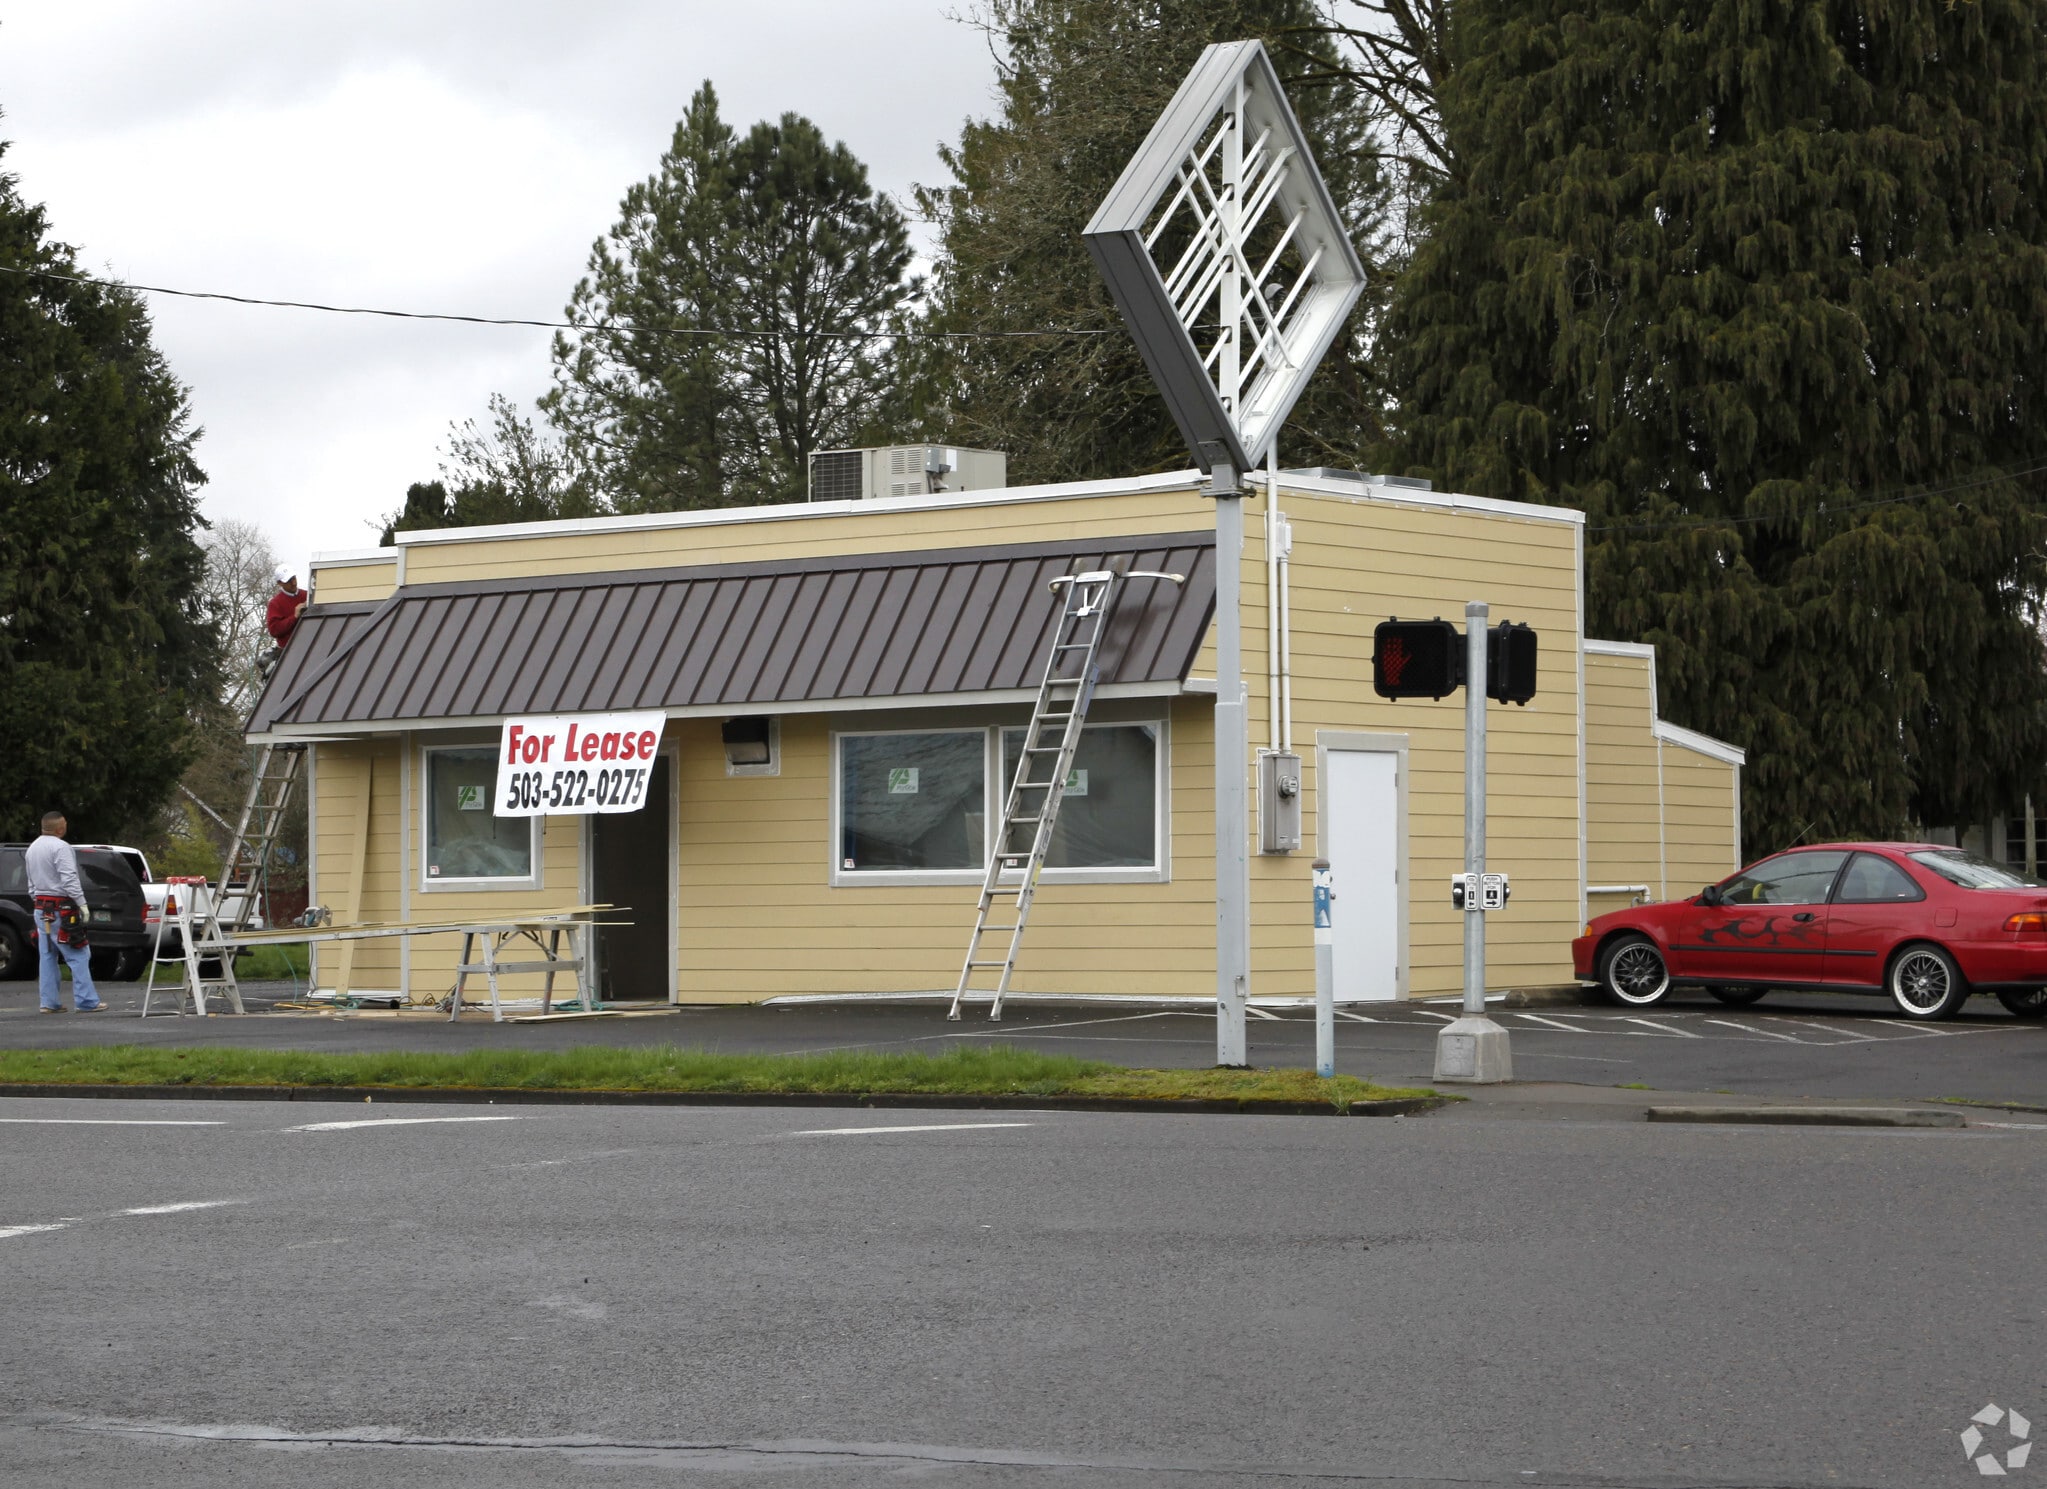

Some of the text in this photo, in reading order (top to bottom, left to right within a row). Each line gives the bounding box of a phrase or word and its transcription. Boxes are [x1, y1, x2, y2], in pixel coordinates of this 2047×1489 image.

[508, 723, 657, 765] For Lease
[506, 768, 647, 810] 503-522-0275
